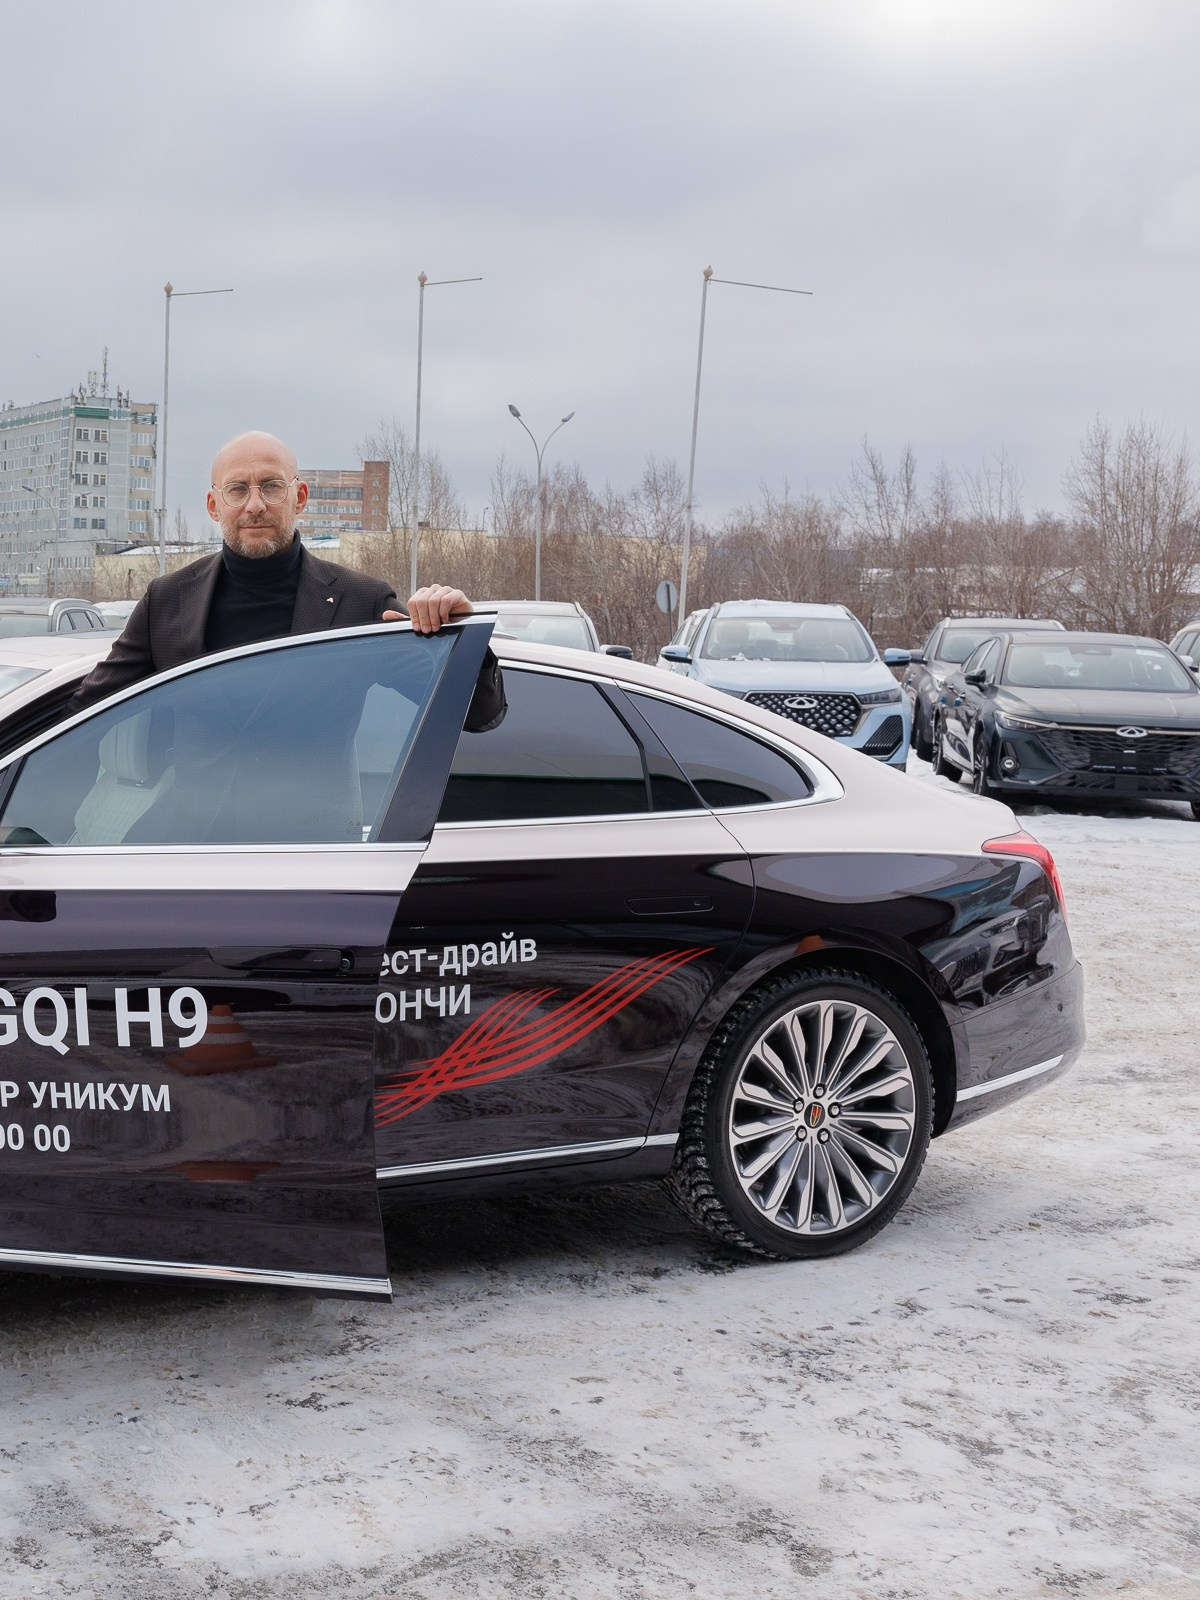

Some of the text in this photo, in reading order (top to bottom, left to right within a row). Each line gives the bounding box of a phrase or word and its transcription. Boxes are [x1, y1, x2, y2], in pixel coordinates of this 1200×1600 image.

[115, 986, 208, 1048] H9
[27, 1081, 171, 1112] УНИКУМ
[33, 1124, 71, 1153] 00
